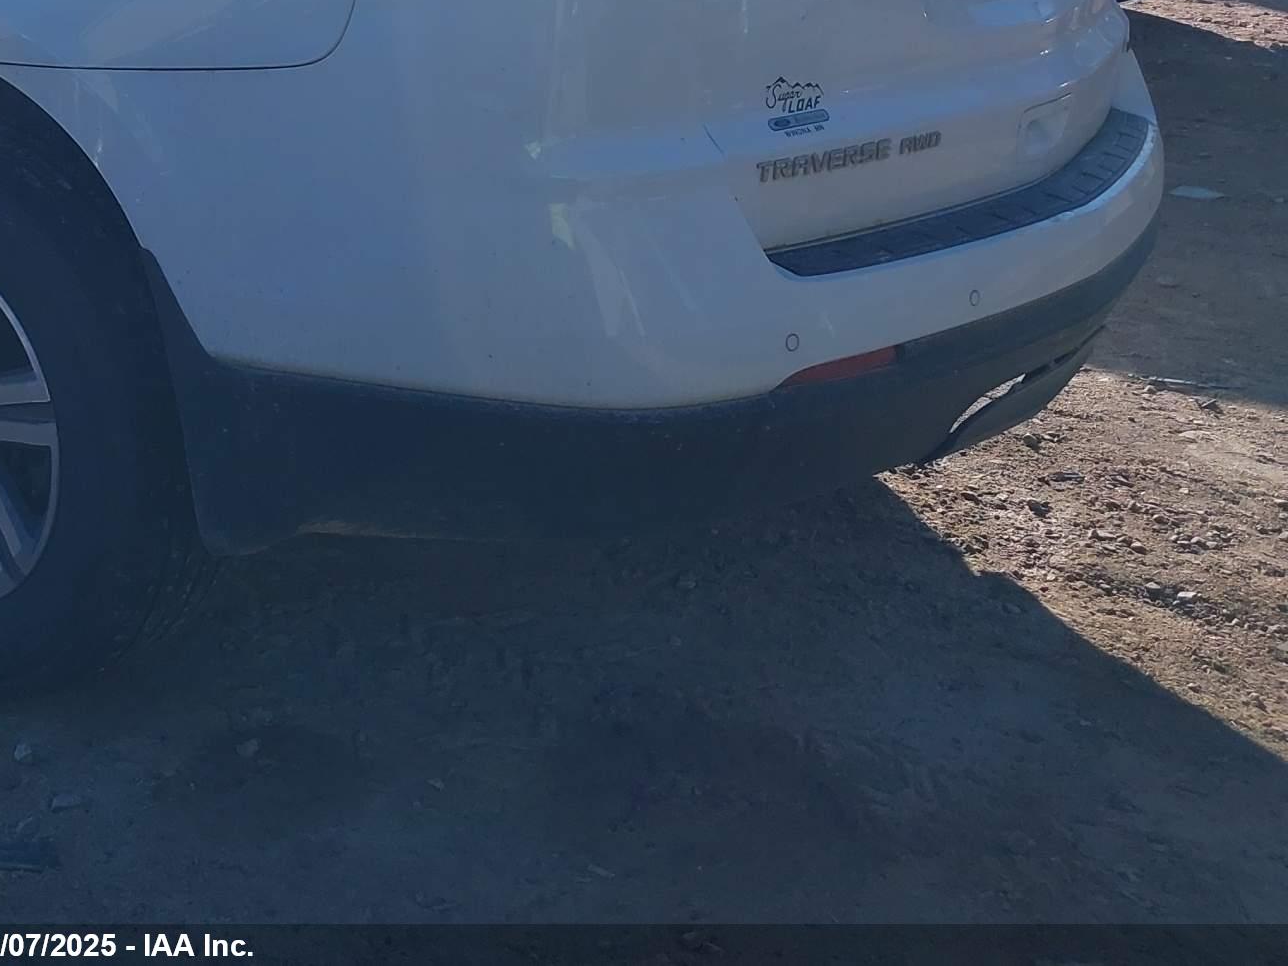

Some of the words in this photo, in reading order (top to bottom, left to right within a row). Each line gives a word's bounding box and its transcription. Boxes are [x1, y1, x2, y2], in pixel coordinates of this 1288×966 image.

[788, 95, 822, 114] LOAF
[756, 137, 892, 183] TRAVERSE
[899, 130, 942, 155] AWD
